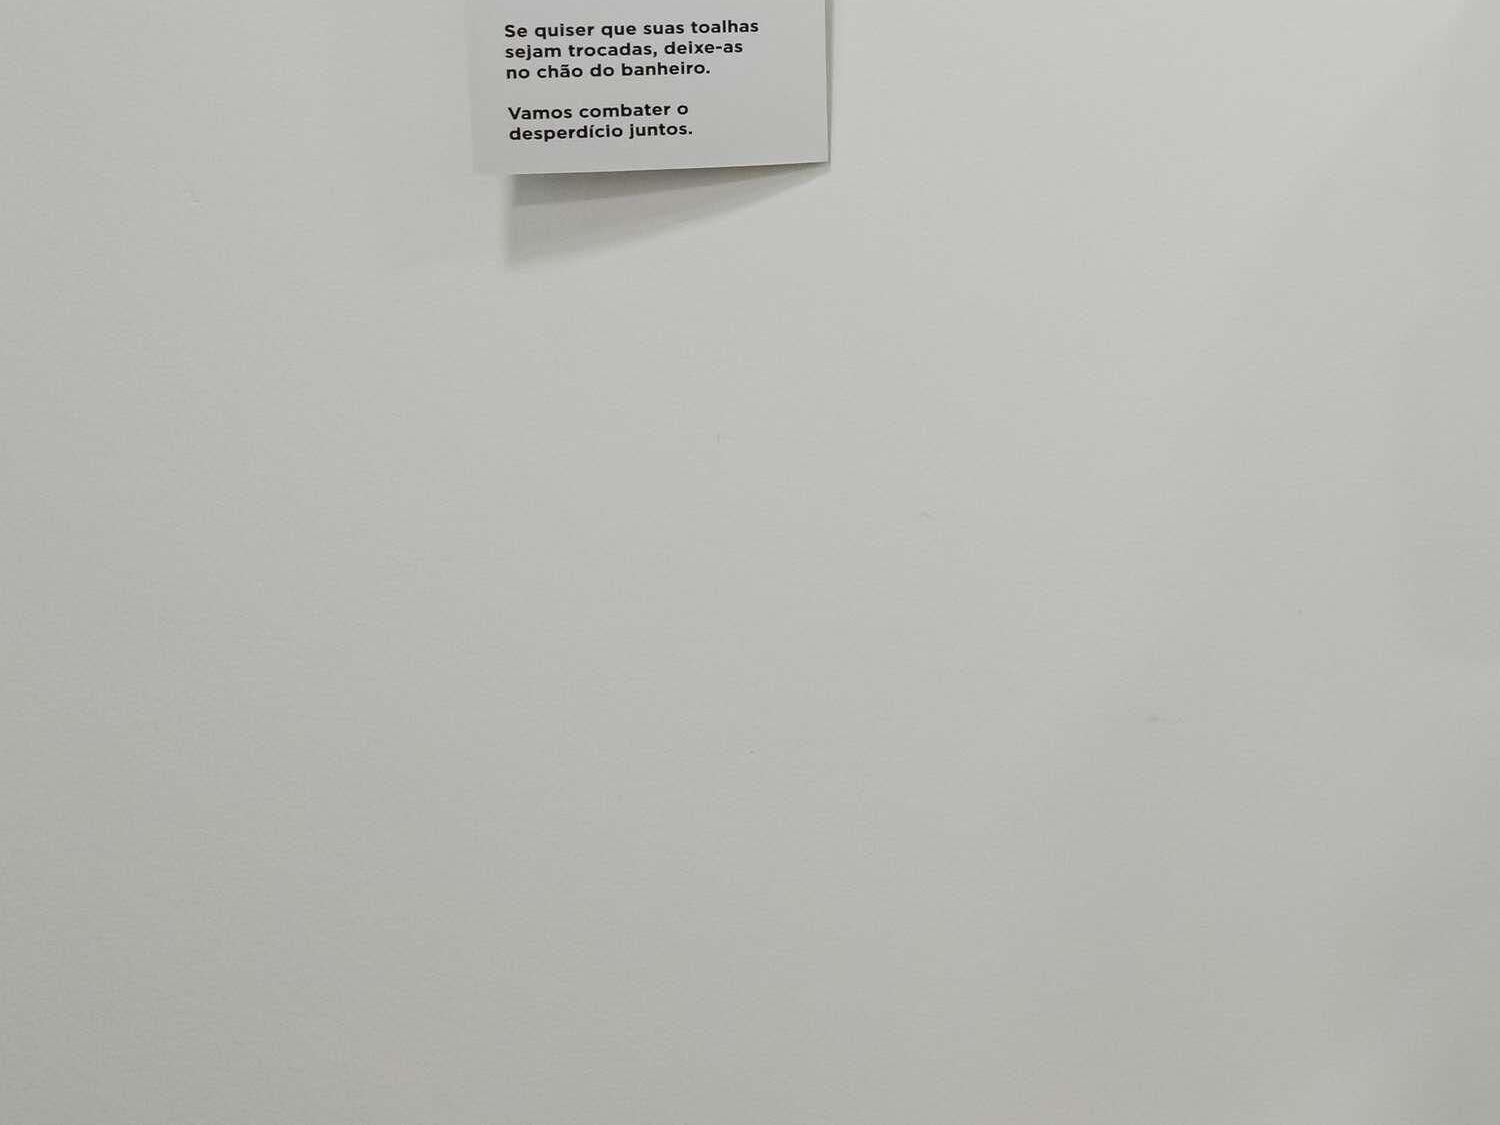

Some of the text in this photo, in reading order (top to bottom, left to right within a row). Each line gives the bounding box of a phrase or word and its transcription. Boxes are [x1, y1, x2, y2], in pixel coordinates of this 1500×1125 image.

[504, 19, 759, 40] Se quiser que suas toalhas
[504, 40, 743, 61] sejam trocadas, deixe-as
[506, 61, 711, 80] no chão do banheiro.
[507, 103, 689, 121] Vamos combater o
[508, 123, 693, 143] desperdício juntos.
